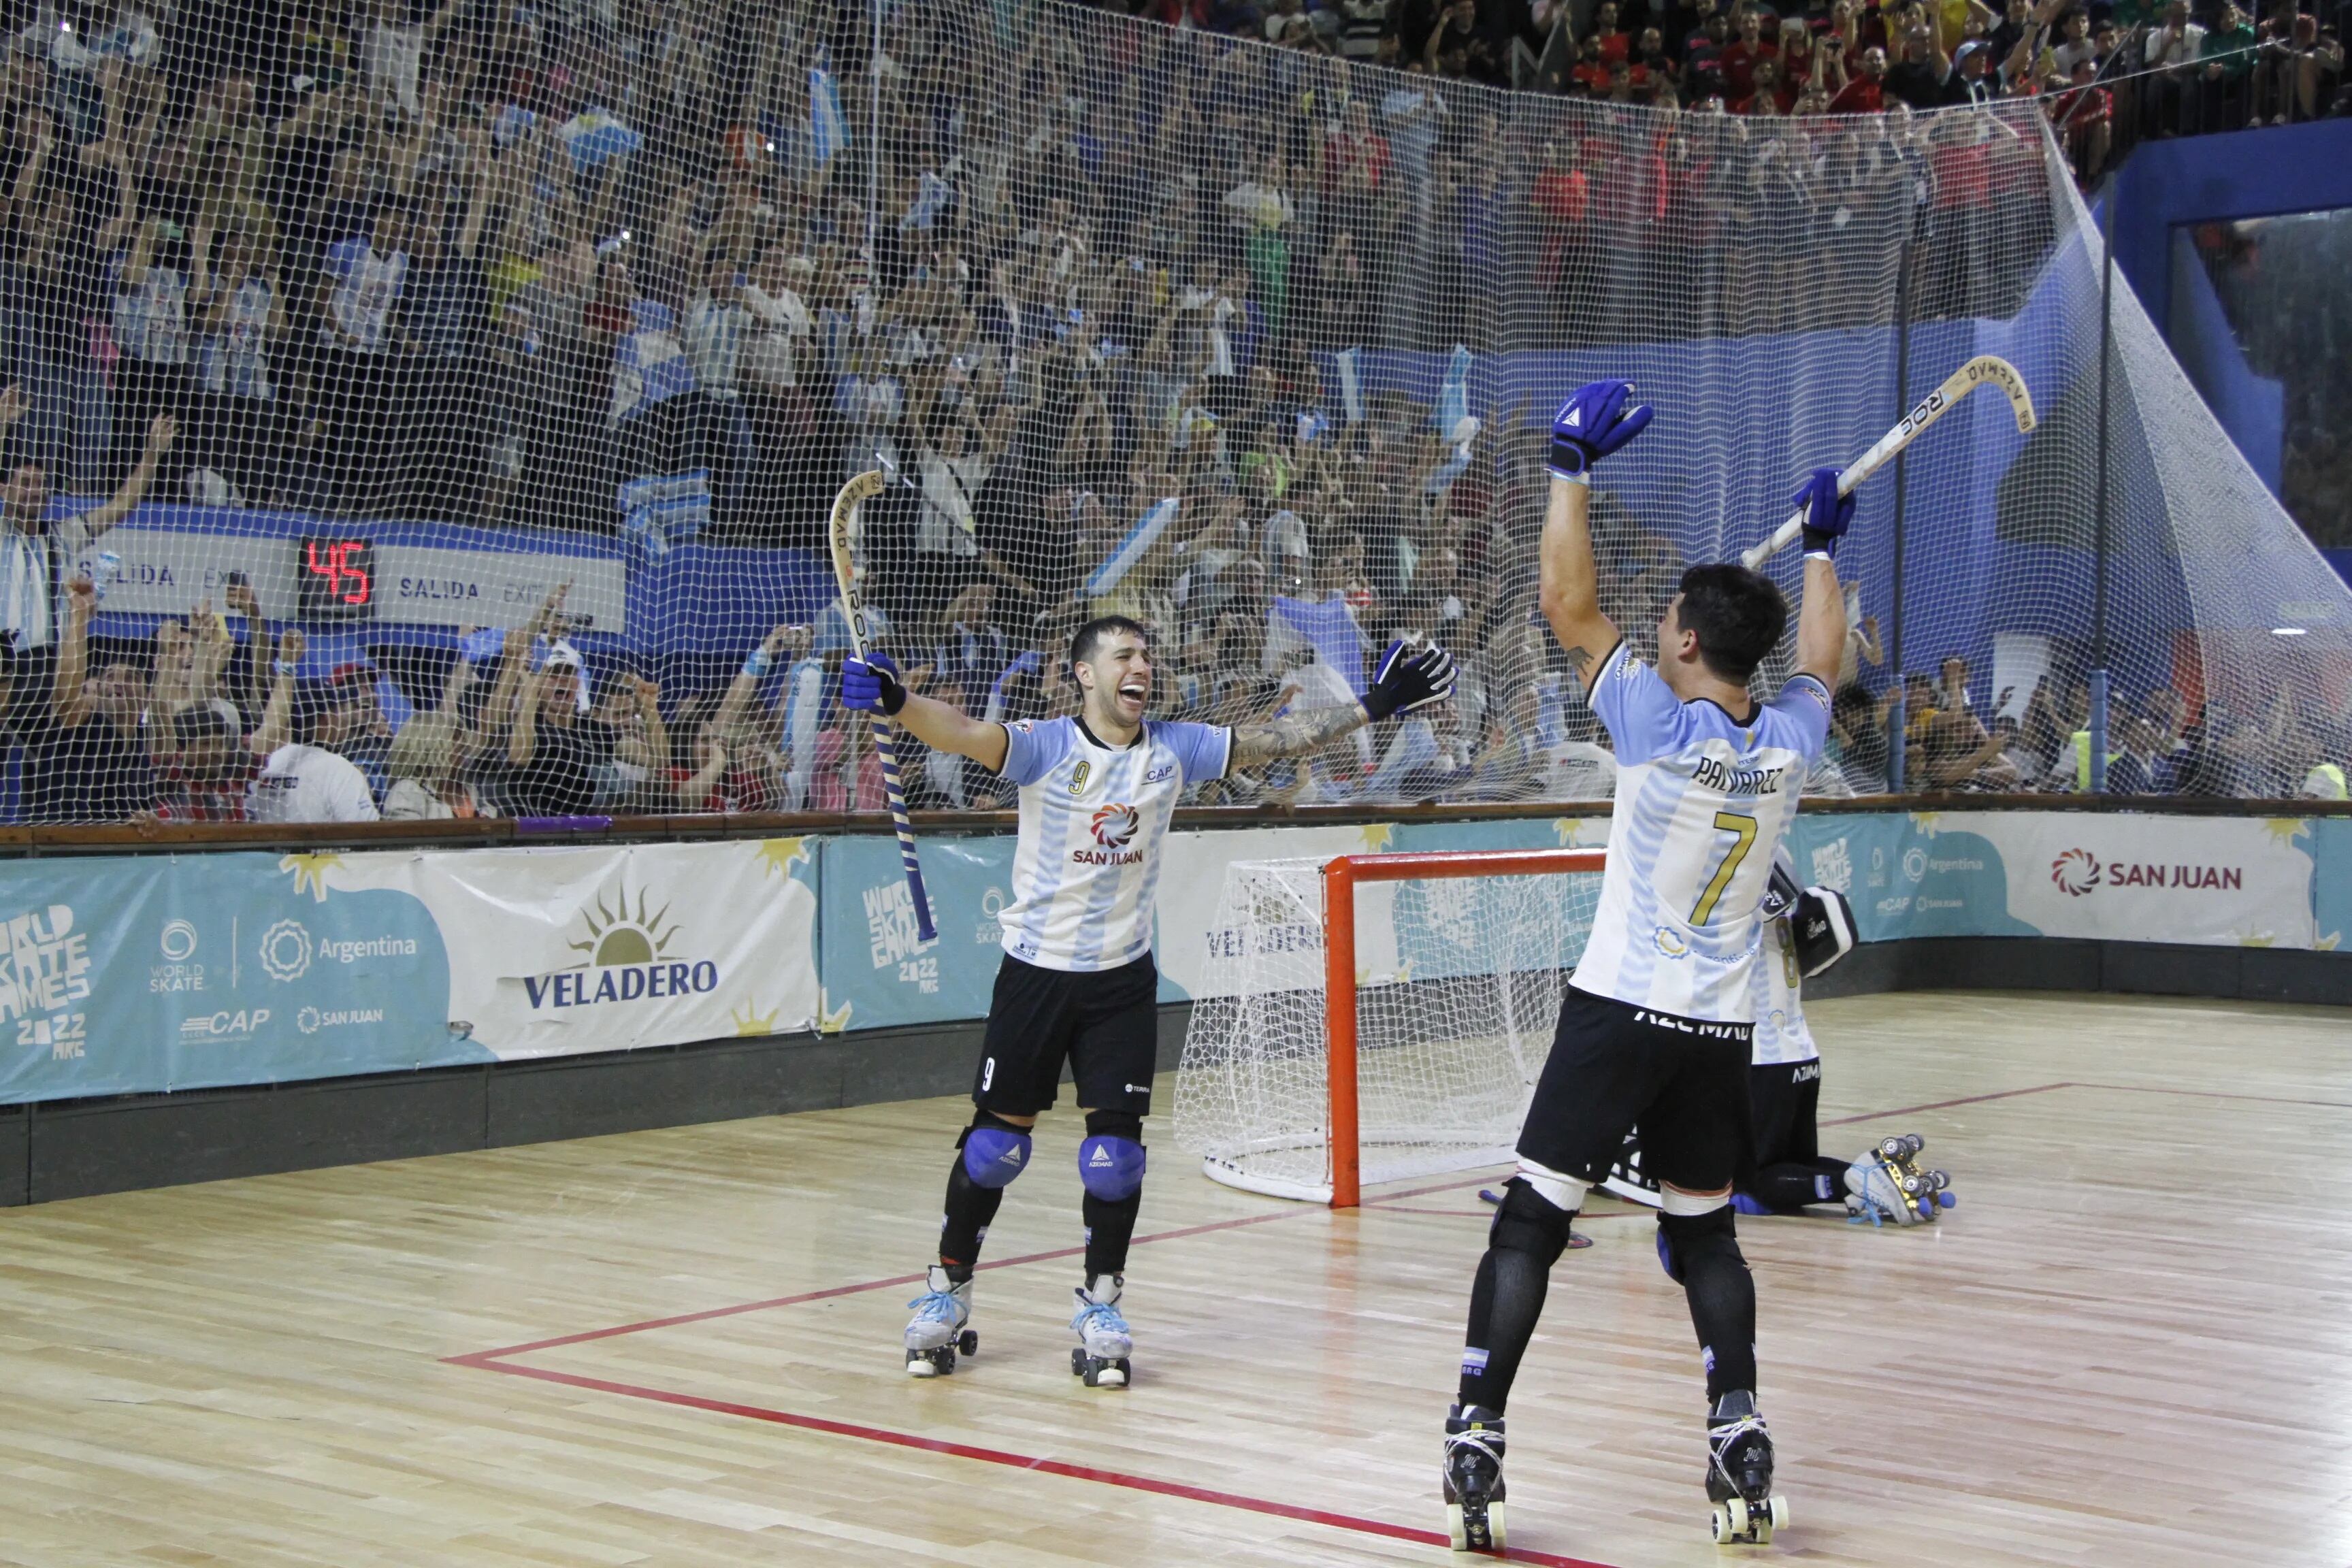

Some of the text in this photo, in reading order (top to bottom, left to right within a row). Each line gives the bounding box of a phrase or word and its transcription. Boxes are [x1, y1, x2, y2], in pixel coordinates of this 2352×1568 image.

[78, 559, 175, 588] SLIDA
[308, 542, 368, 604] 45
[400, 578, 544, 604] SALIDA EXIT
[1068, 760, 1090, 795] 9
[1147, 765, 1173, 781] CAP
[1073, 849, 1143, 866] SAN JUAN
[1688, 811, 1759, 928] 7
[2108, 863, 2242, 890] SAN JUAN
[318, 934, 416, 964] Argentina
[976, 932, 1003, 945] SKAT
[150, 964, 204, 979] WORLD
[150, 977, 204, 993] SKATE
[523, 960, 719, 1010] VELADERO
[208, 1009, 270, 1034] CAP
[322, 1009, 384, 1028] SAN JUAN
[982, 1057, 996, 1092] 9
